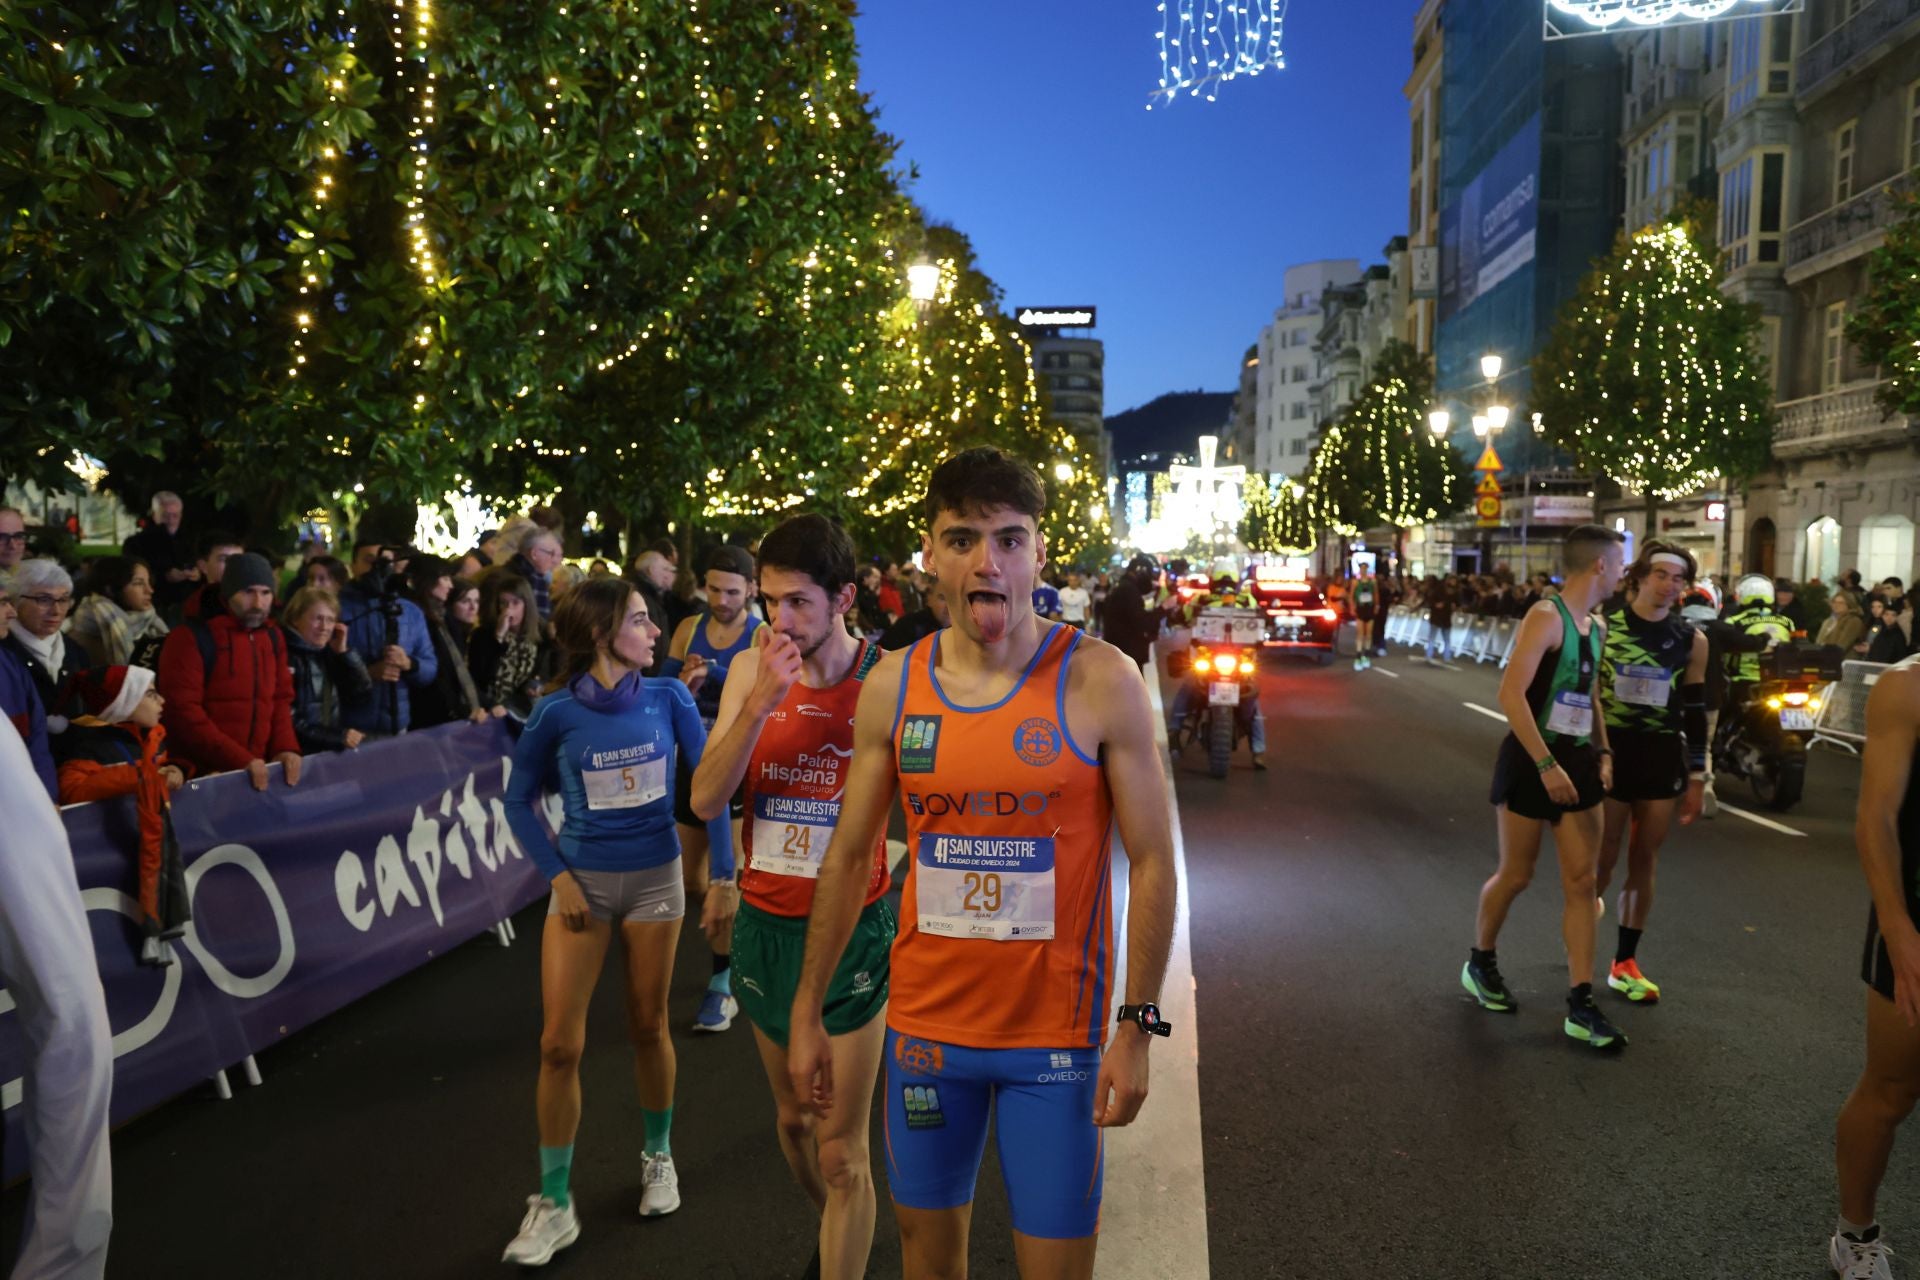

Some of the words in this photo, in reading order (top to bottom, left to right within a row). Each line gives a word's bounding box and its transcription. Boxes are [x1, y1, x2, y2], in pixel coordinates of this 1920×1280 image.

[592, 753, 603, 768] 41
[603, 750, 619, 762] SAN
[619, 742, 655, 759] SILVESTRE
[798, 754, 838, 770] Patria
[622, 767, 635, 791] 5
[762, 762, 836, 785] Hispana
[800, 784, 834, 793] seguros
[765, 797, 774, 817] 41
[775, 799, 793, 812] SAN
[793, 800, 840, 816] SILVESTRE
[926, 791, 1048, 816] OVIEDO
[783, 824, 810, 855] 24
[934, 838, 947, 863] 41
[949, 838, 972, 856] SAN
[974, 840, 1036, 857] SILVESTRE
[981, 859, 1004, 867] OVIEDO
[963, 872, 1002, 912] 29
[1038, 1071, 1087, 1083] OVIEDO
